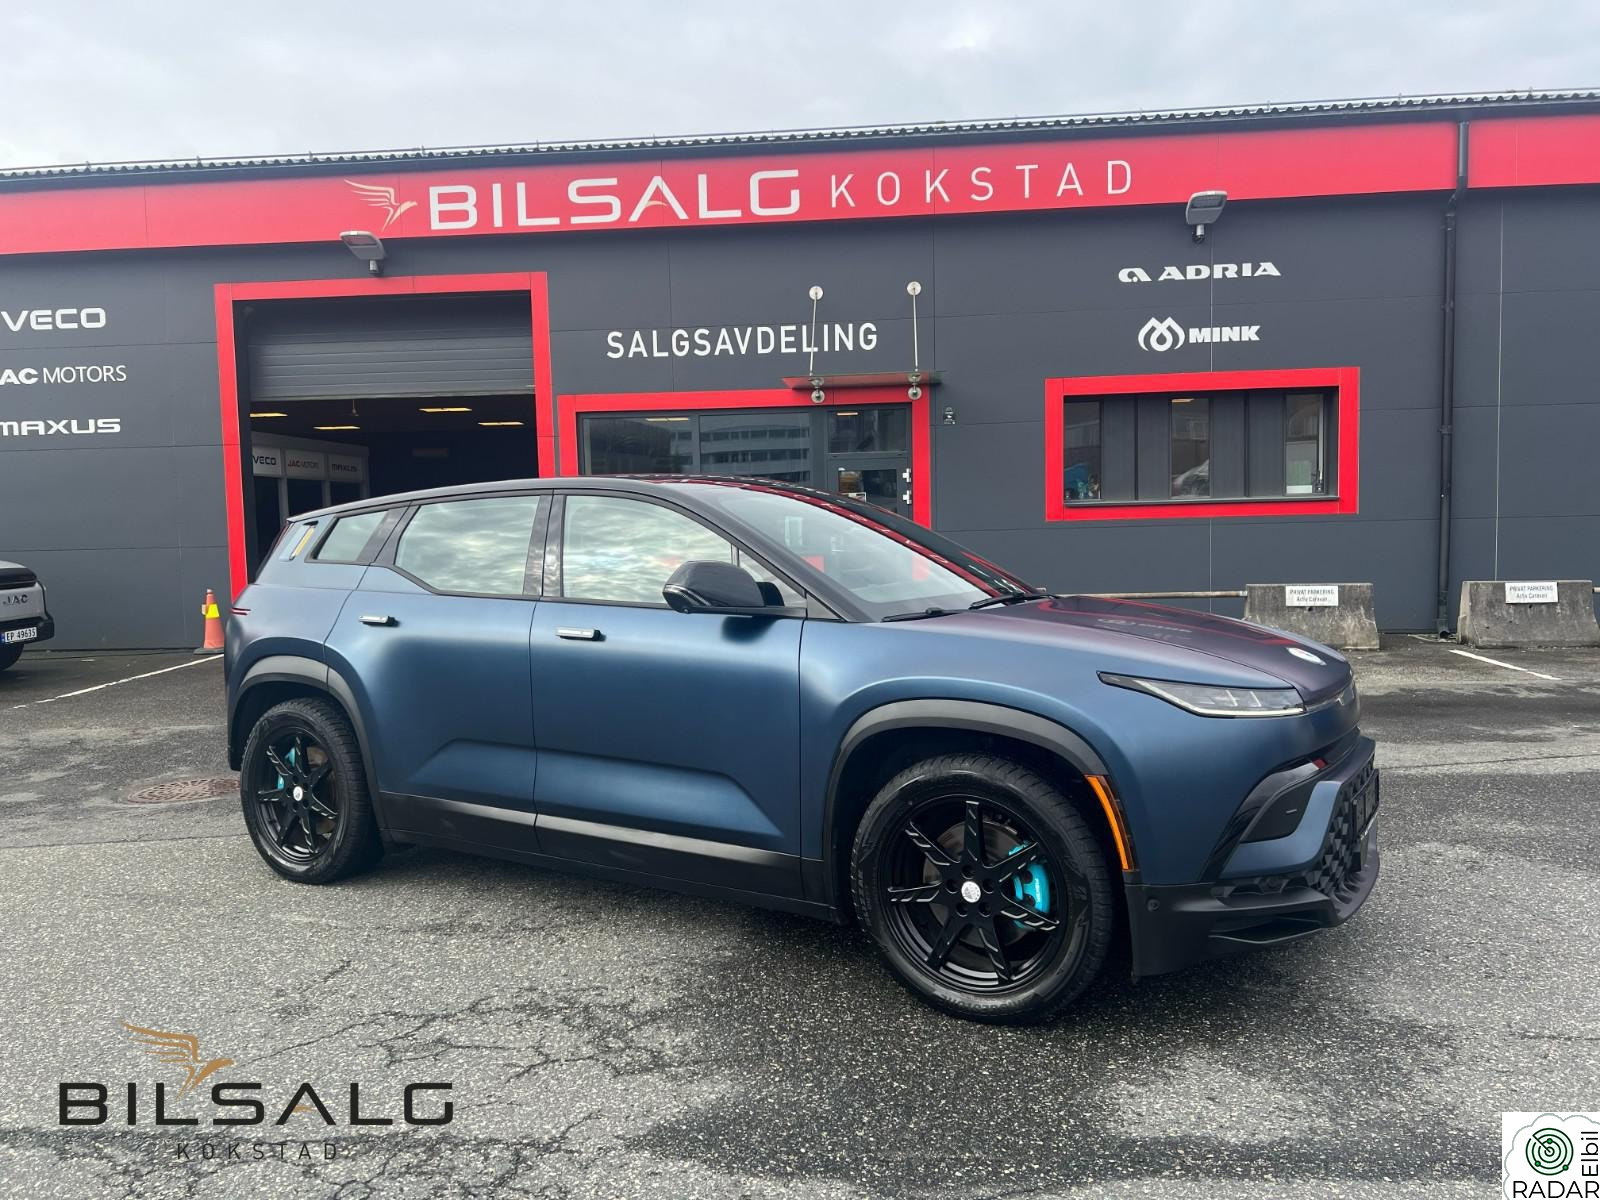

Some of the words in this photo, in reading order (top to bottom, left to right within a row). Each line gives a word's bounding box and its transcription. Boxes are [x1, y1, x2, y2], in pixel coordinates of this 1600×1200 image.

[429, 169, 801, 231] BILSALG
[831, 160, 1132, 208] KOKSTAD
[1158, 262, 1281, 281] ADRIA
[606, 322, 878, 359] SALGSAVDELING
[1189, 325, 1260, 343] MINK
[43, 365, 127, 384] MOTORS
[3, 594, 28, 605] JAC
[6, 632, 15, 641] EP
[17, 628, 36, 639] 49635
